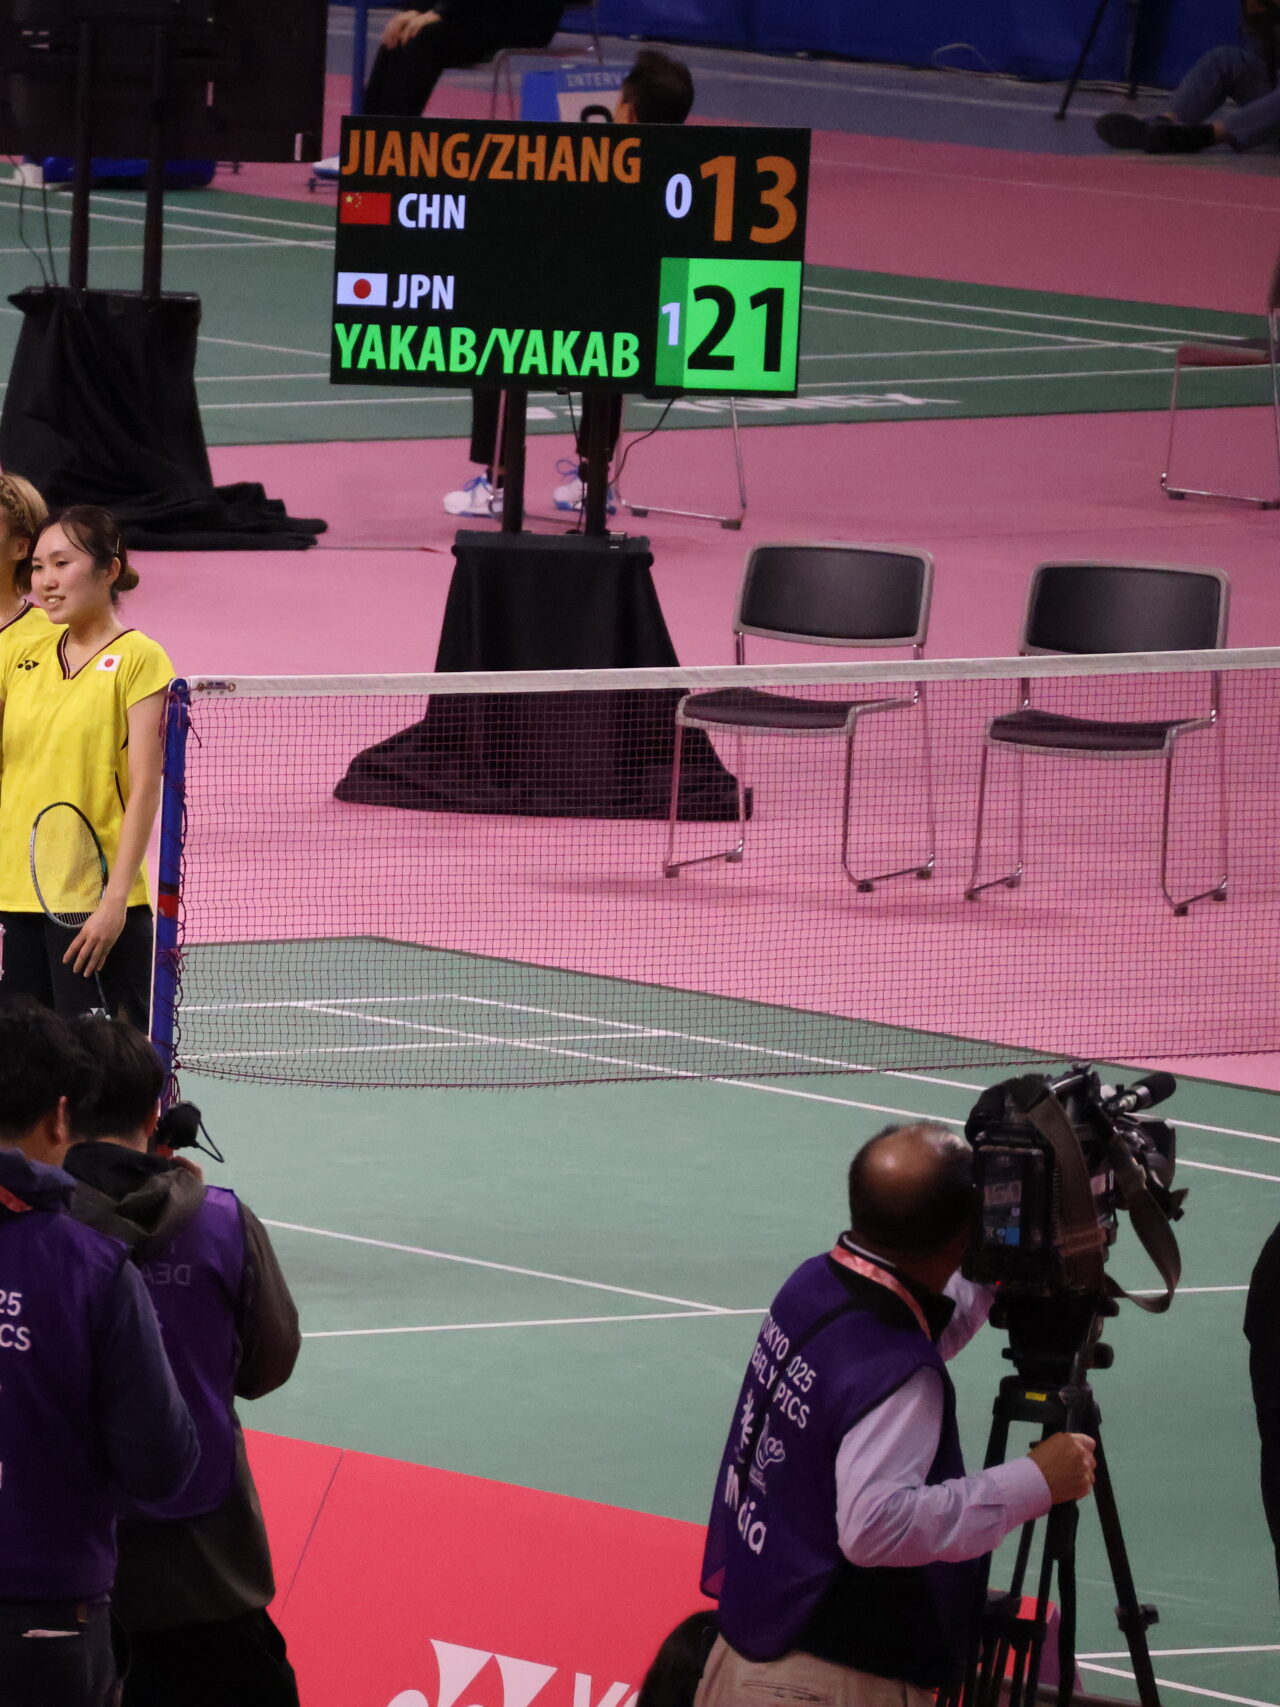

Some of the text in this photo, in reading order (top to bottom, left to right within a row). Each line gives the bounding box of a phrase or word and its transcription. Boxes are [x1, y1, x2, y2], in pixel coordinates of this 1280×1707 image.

[341, 130, 642, 184] JIANG/ZHANG
[398, 193, 466, 229] CHN
[665, 155, 798, 244] 0 13
[393, 275, 455, 310] JPN
[335, 323, 640, 378] YAKAB/YAKAB
[661, 284, 785, 373] 1 21
[785, 1355, 817, 1393] 025
[724, 1464, 767, 1555] Mdia
